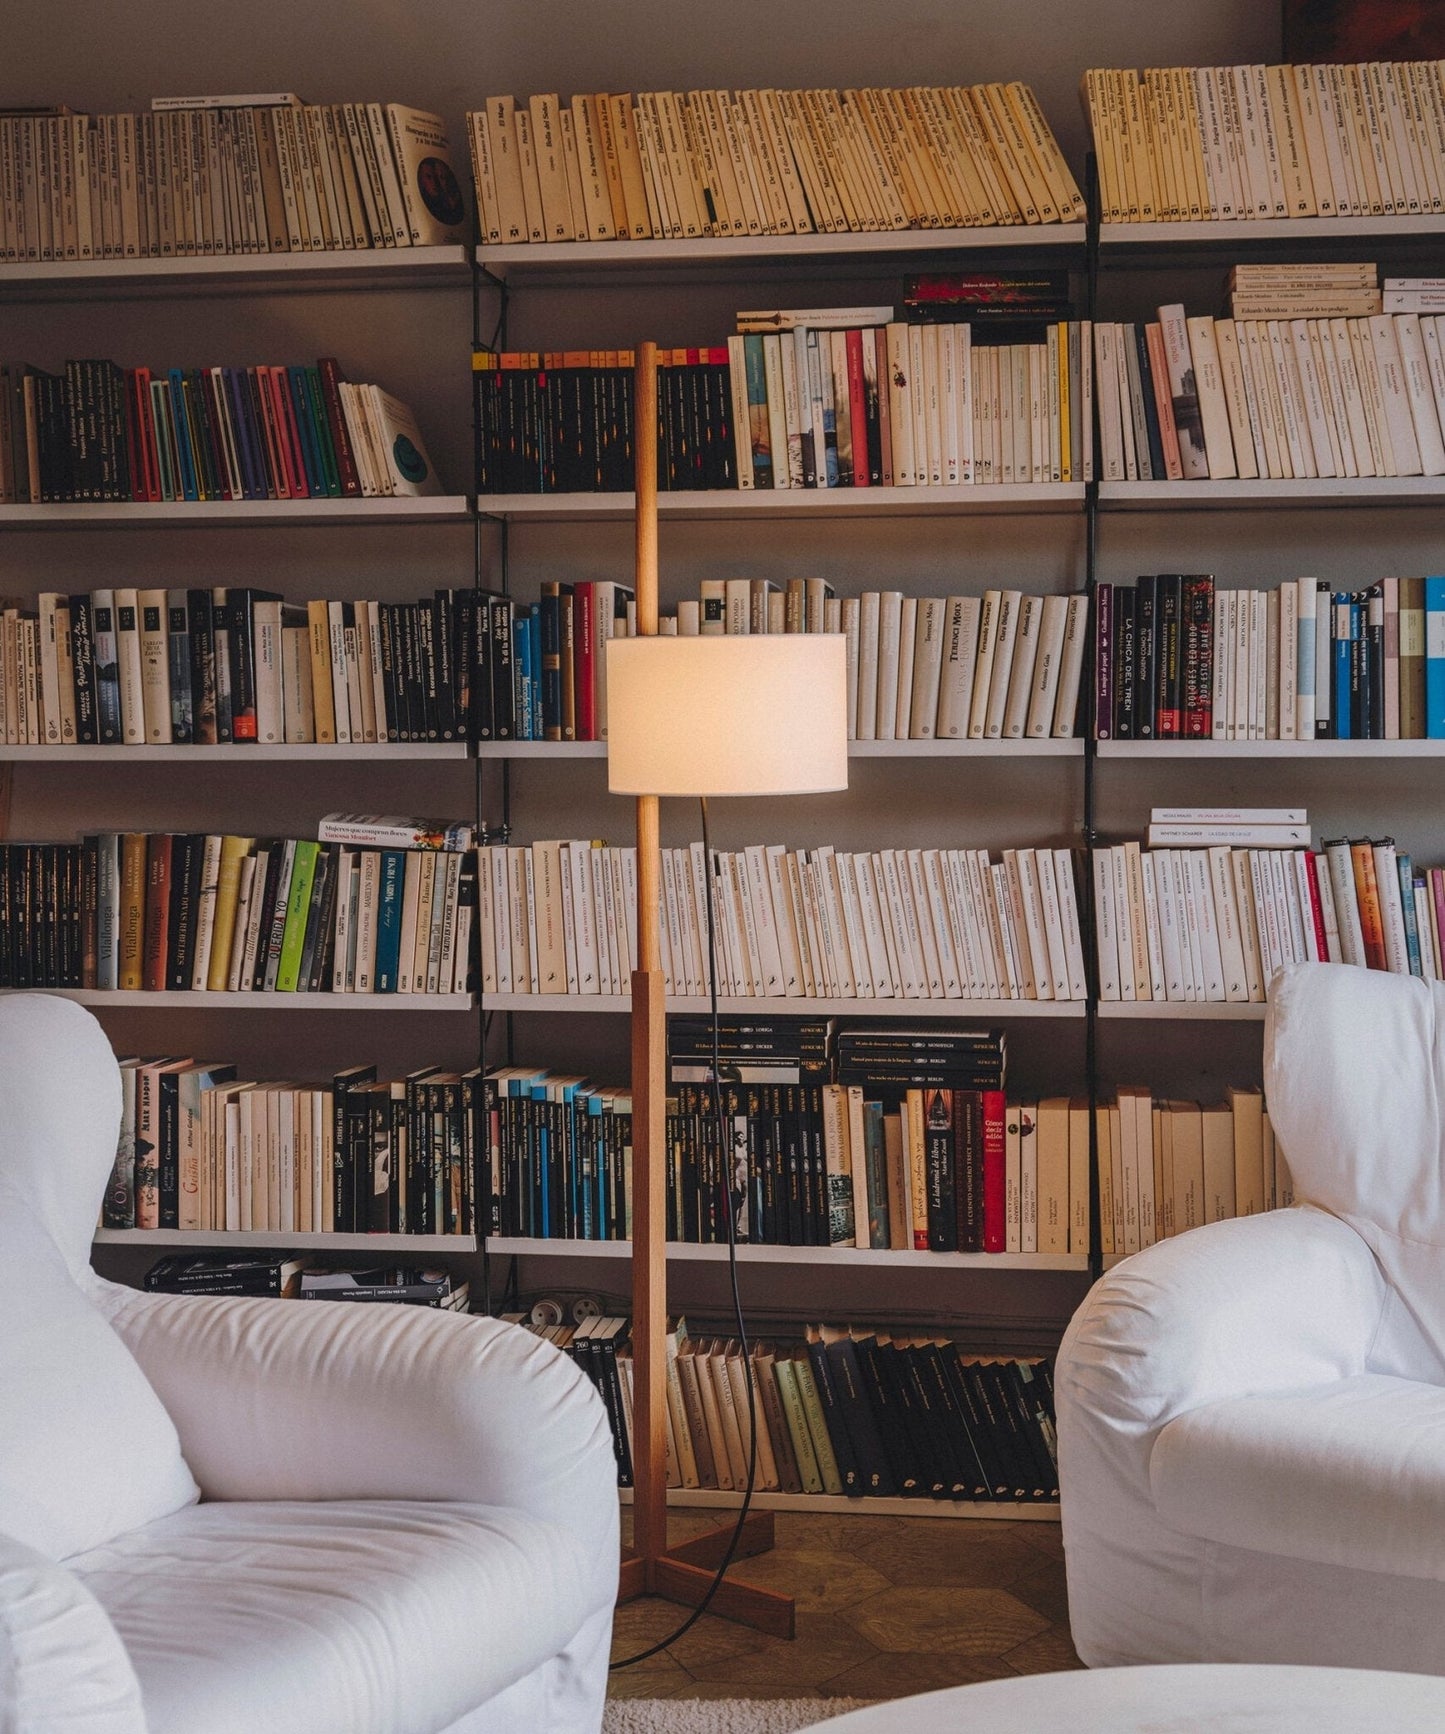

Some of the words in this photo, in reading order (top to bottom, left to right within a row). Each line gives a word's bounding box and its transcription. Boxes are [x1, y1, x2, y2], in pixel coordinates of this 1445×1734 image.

[1125, 618, 1133, 630] LA
[1125, 632, 1133, 660] CHICA
[1124, 665, 1133, 684] DEL
[1124, 687, 1132, 712] TREN
[275, 900, 287, 913] YO
[100, 905, 114, 961] Vilallonga
[125, 905, 140, 960] Vilallonga
[268, 916, 285, 960] QUERIDA
[930, 1138, 939, 1159] libros
[931, 1169, 940, 1197] ladrona
[932, 1198, 940, 1208] La
[576, 1341, 589, 1349] 760
